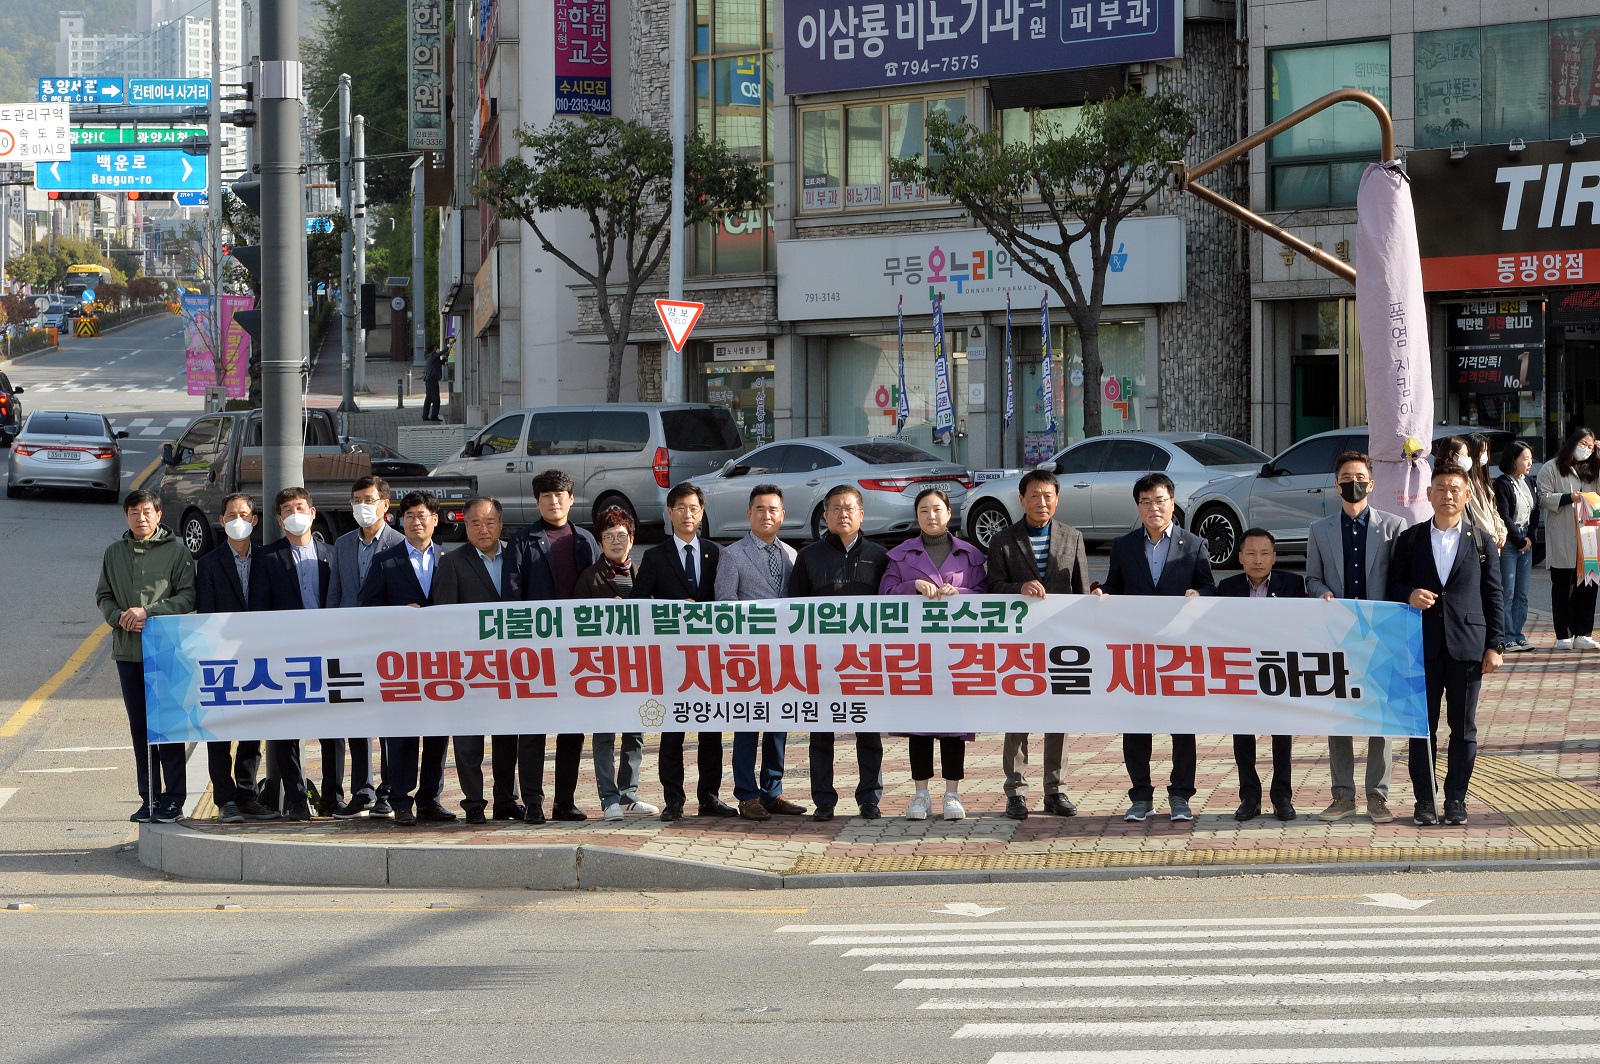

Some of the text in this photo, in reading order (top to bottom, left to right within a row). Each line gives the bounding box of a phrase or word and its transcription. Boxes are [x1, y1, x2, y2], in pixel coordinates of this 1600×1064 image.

[1070, 0, 1151, 33] 피부과
[568, 0, 591, 63] 학교
[591, 0, 608, 65] 캠퍼스)
[797, 0, 1024, 61] 이삼룡 비뇨기과
[412, 5, 442, 115] 한의원
[901, 55, 979, 76] 794-7575
[132, 84, 208, 99] 컨테이너 사거리
[559, 80, 607, 95] 수시모집
[555, 97, 611, 112] 010-2313-9443
[1, 108, 63, 122] 도관리구역
[20, 143, 66, 156] 줄이시오
[411, 138, 444, 147] 794-3336
[97, 154, 148, 172] 백운로
[91, 173, 153, 187] Baegun-ro
[805, 189, 839, 206] 피부과
[846, 186, 882, 204] 비뇨기과
[891, 183, 925, 201] 피부과
[1496, 252, 1584, 283] 동광양점
[804, 291, 841, 303] 791-3143
[965, 284, 1038, 295] ONNURI PHARMACY
[667, 306, 689, 317] 양보
[1456, 315, 1533, 331] 백만번 기원합니다
[1458, 355, 1502, 369] 가격만족!
[1457, 370, 1502, 383] 고객만족!
[1394, 357, 1415, 416] 지킴이
[1104, 376, 1133, 421] 약
[478, 602, 1029, 641] 더불어 함께 발전하는 기업시민 포스코?
[197, 641, 1362, 707] 포스코는 일방적인 정비 자회사 설립 결정을 재검토하라.
[673, 701, 869, 724] 광양시의회 의원 일동
